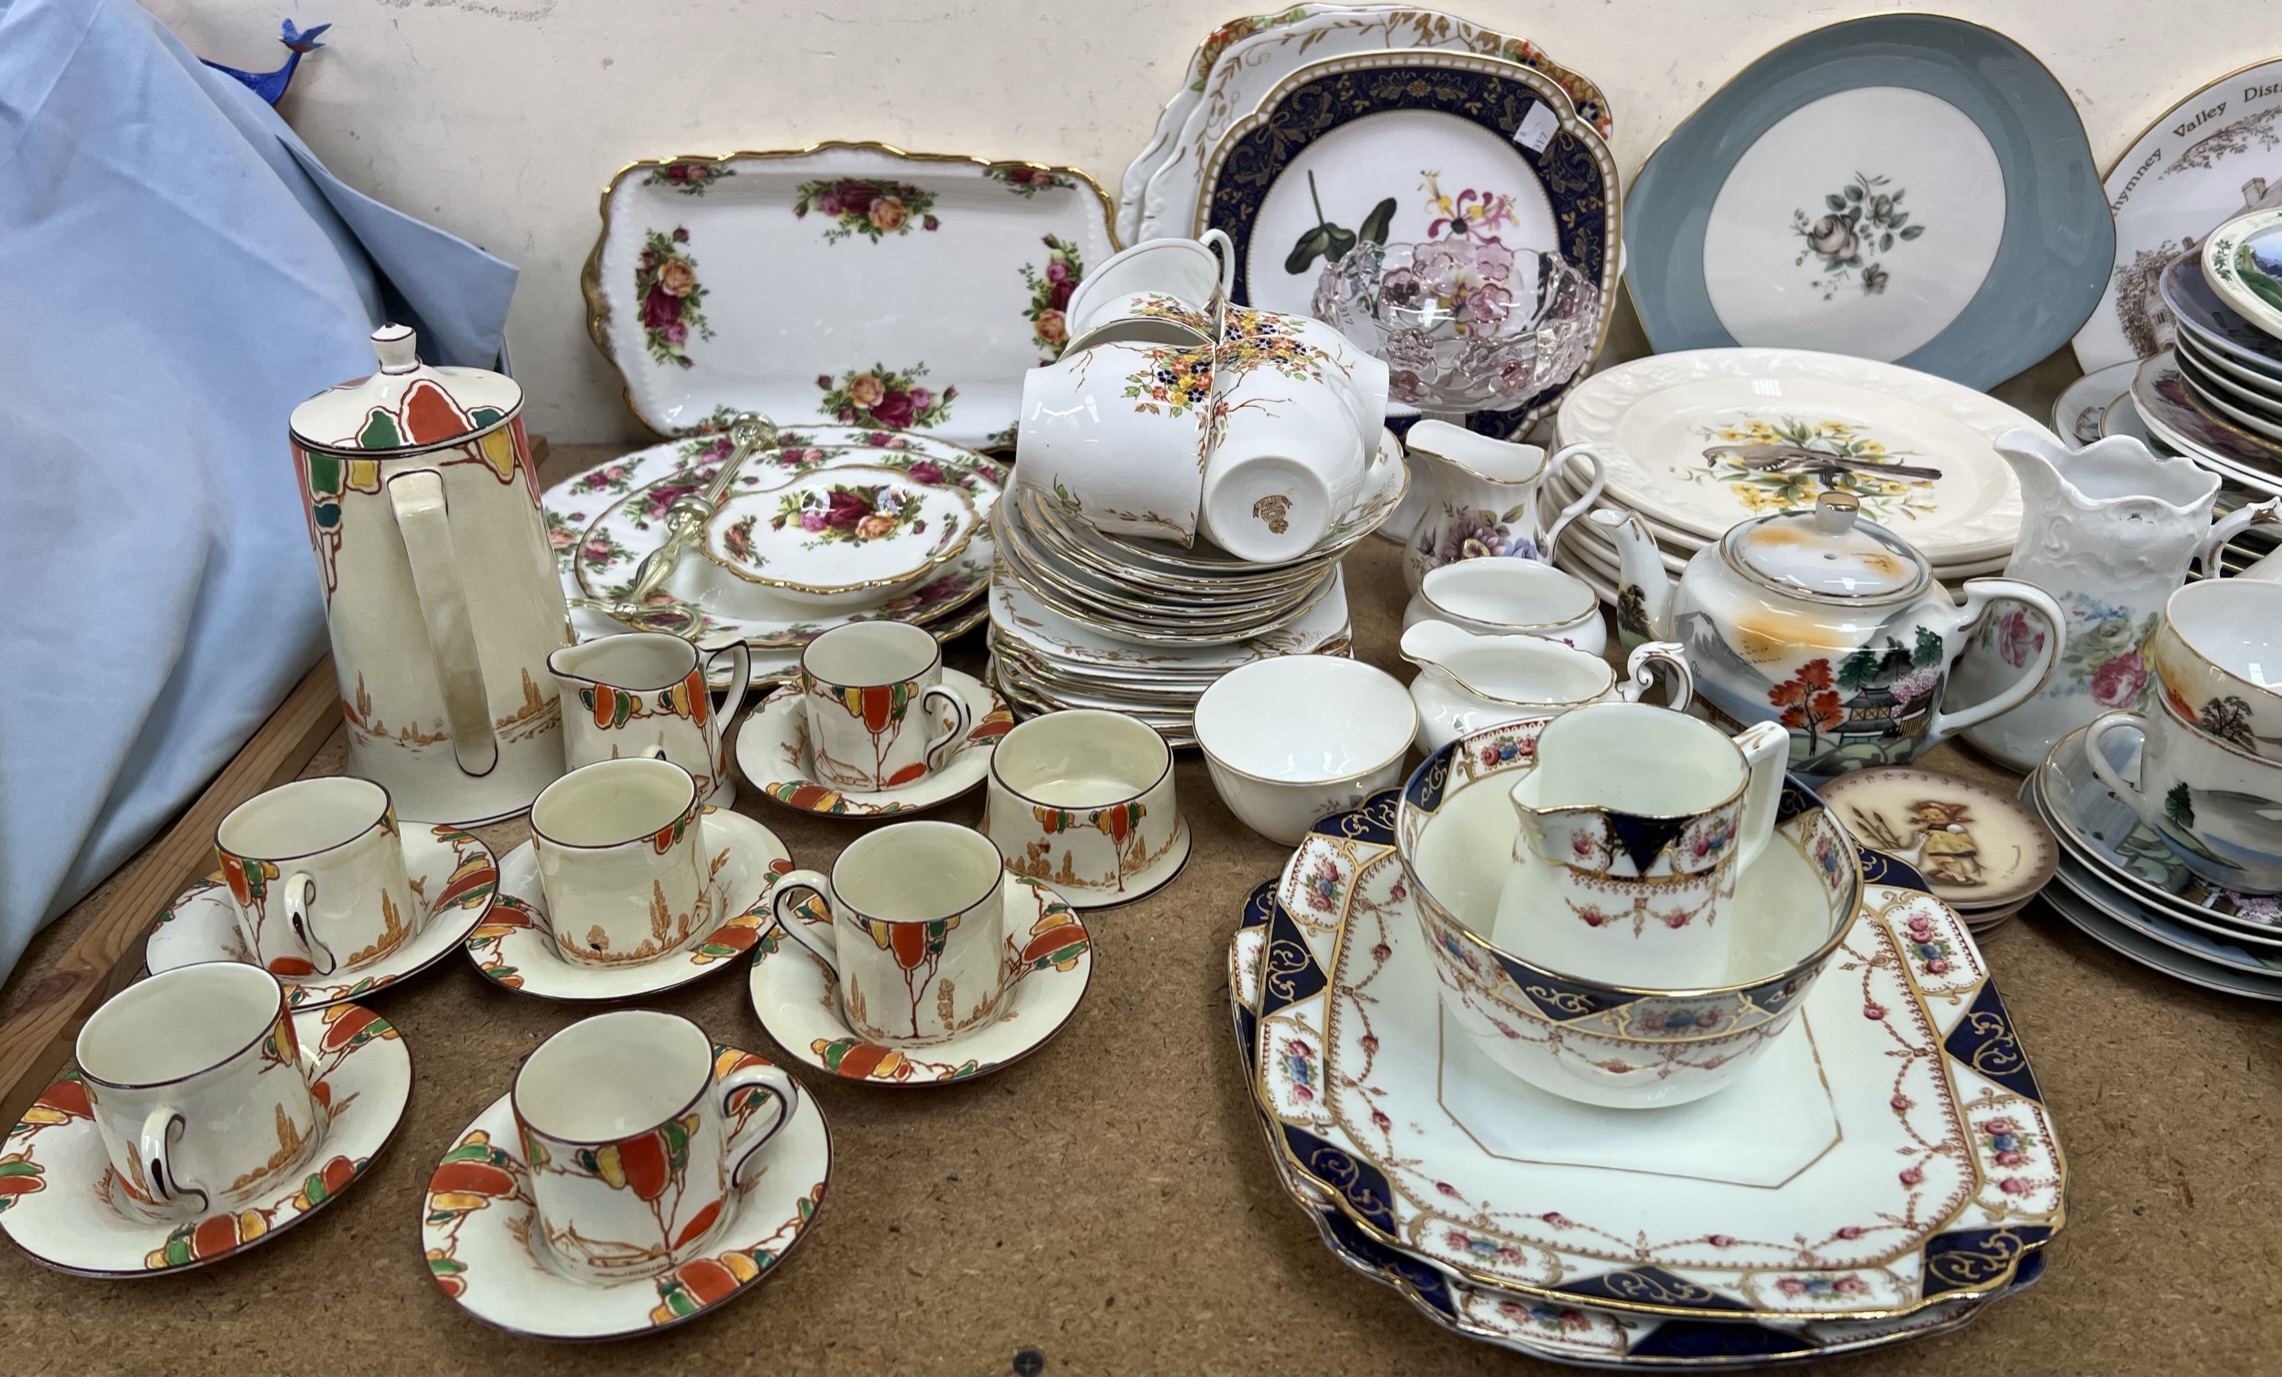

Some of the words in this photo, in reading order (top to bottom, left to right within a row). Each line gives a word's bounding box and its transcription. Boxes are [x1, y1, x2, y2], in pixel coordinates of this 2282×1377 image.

[2110, 147, 2162, 217] hymney
[2173, 101, 2227, 138] Valley
[1339, 306, 1354, 326] 317
